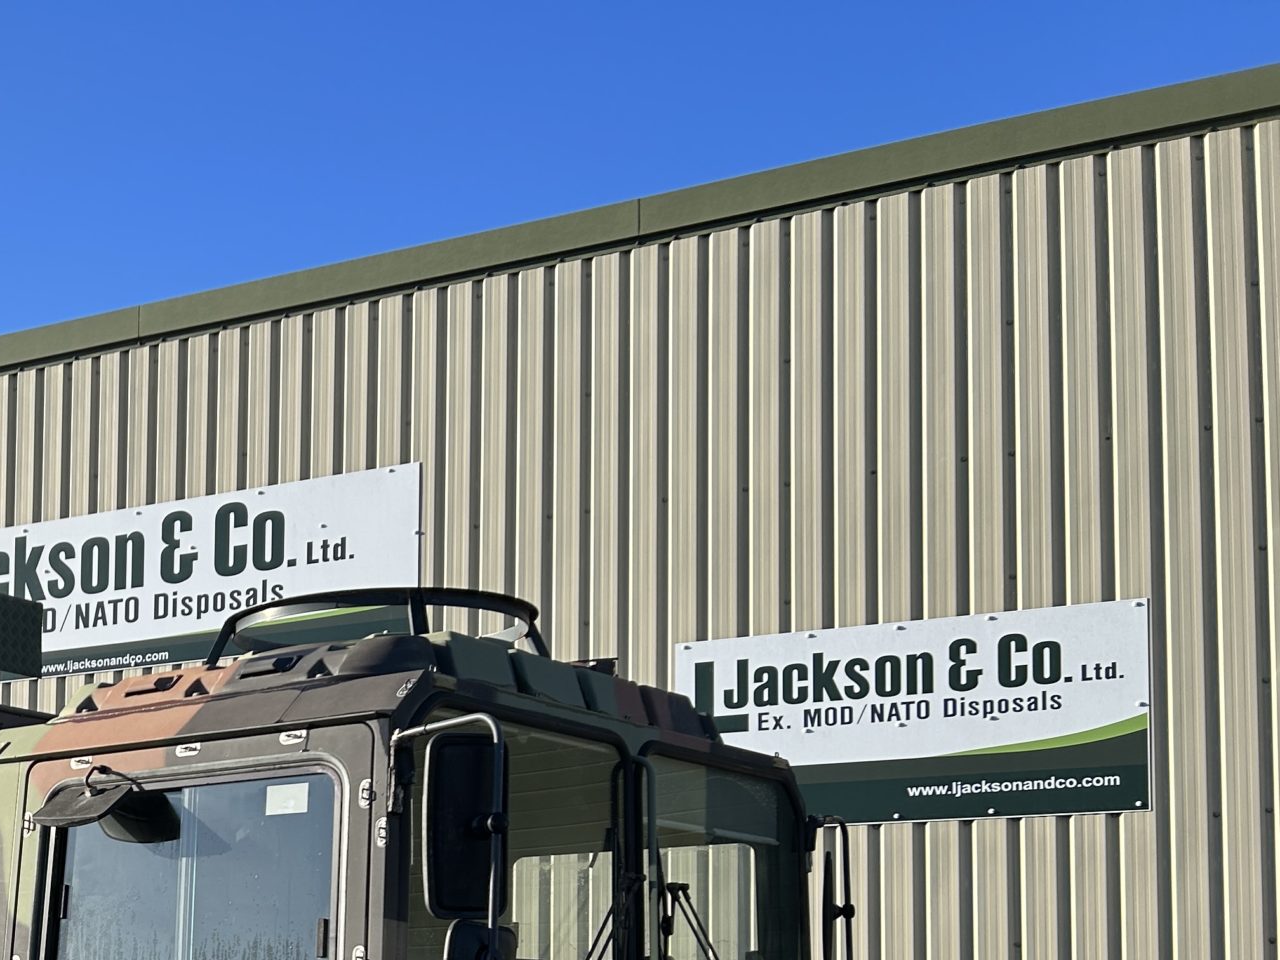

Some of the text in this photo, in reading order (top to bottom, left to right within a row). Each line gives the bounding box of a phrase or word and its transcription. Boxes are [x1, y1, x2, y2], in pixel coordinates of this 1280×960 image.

[161, 510, 198, 584] &
[214, 501, 297, 576] Co.
[307, 537, 355, 565] Ltd.
[42, 579, 284, 633] D/NATO Disposals
[949, 638, 983, 691] &
[997, 633, 1073, 688] Co.
[1081, 662, 1124, 682] Ltd.
[757, 691, 1062, 731] Ex. MOD/NATO Disposals
[907, 775, 1121, 797] www.ljacksonandco.com
